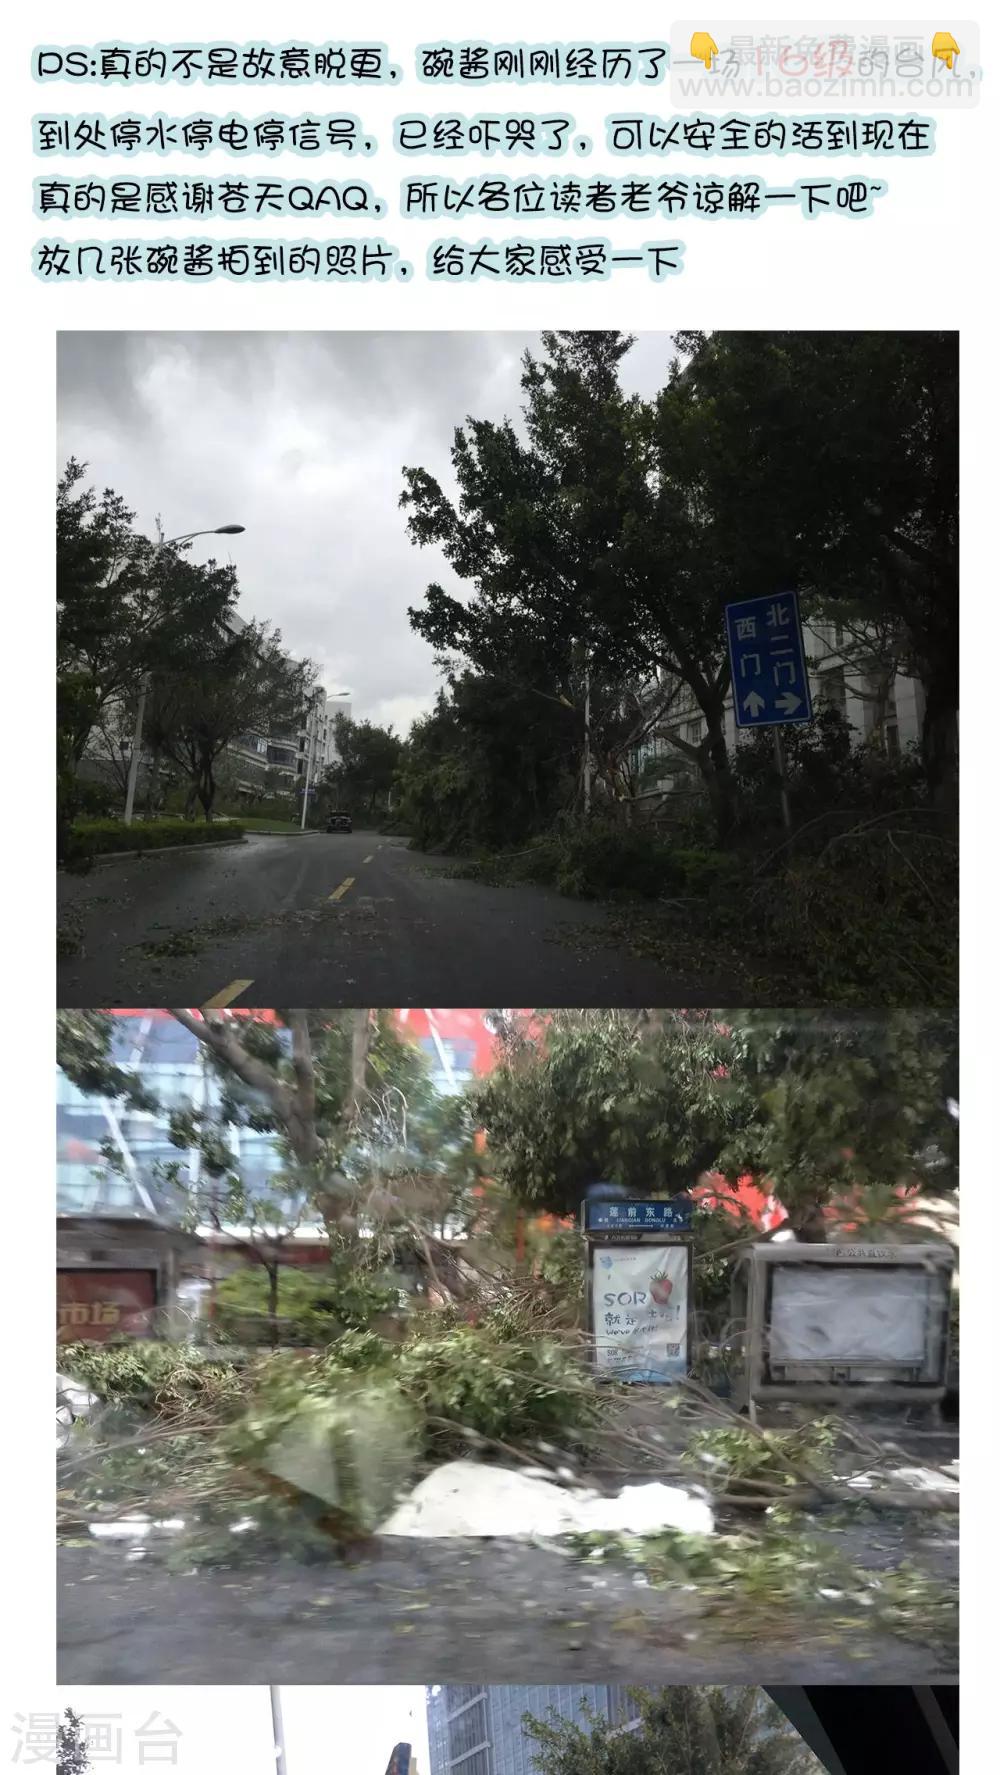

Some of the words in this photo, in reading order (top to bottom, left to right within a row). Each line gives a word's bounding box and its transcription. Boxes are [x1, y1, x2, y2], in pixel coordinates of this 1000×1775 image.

[734, 616, 761, 678] 西门
[766, 602, 796, 687] 北二门
